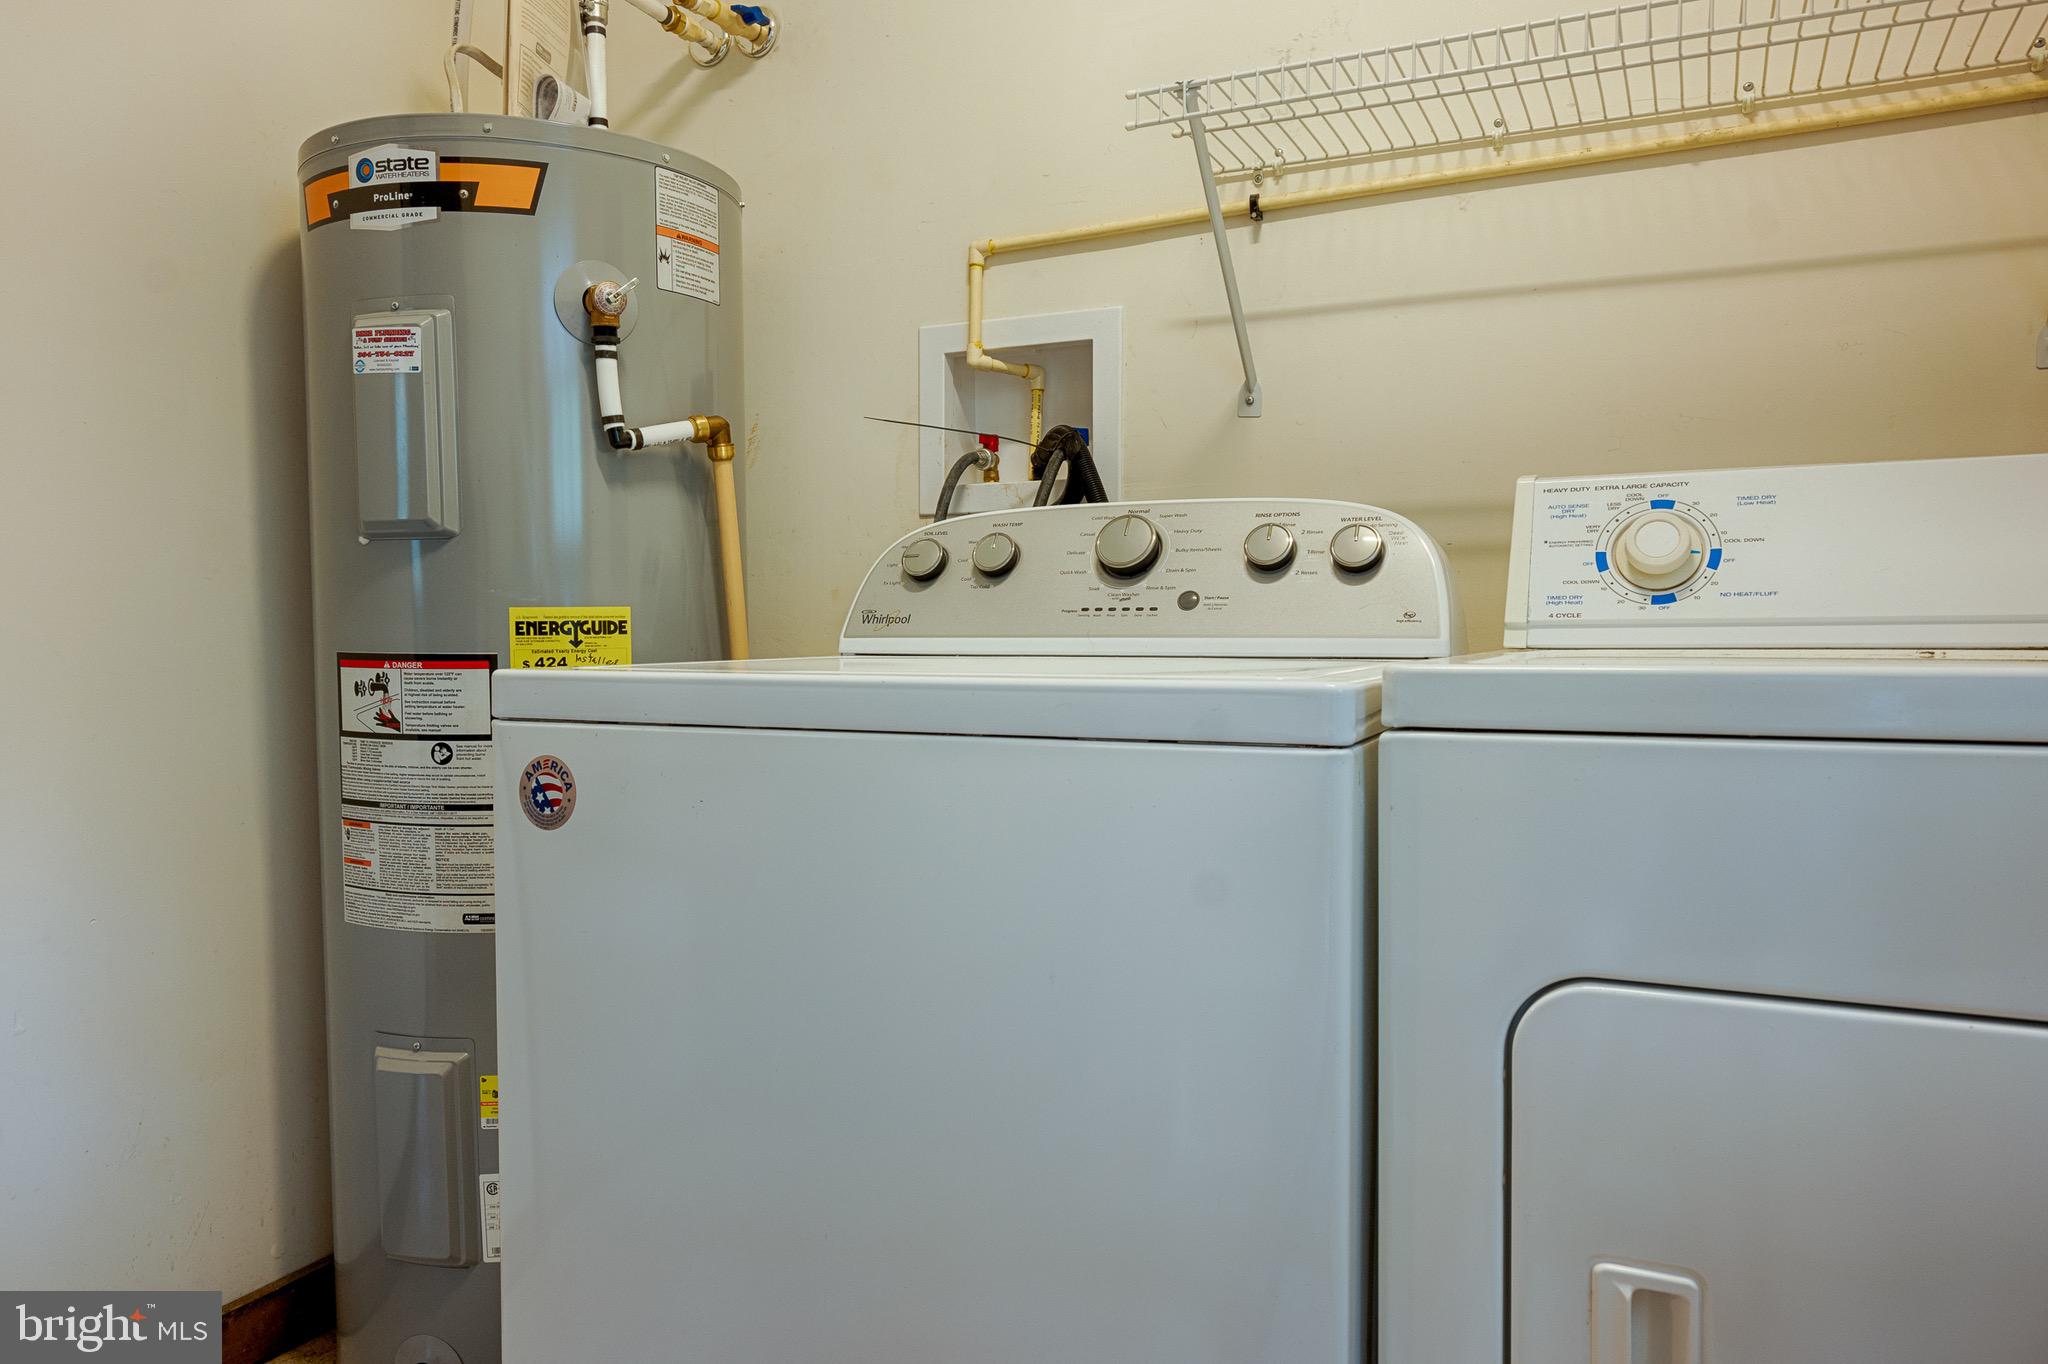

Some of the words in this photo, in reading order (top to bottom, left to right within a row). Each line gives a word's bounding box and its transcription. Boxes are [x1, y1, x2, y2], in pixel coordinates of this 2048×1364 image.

[376, 157, 429, 173] state
[374, 192, 410, 202] ProLine
[862, 613, 911, 627] Whirlpool
[515, 620, 628, 636] ENERGYGUIDE
[535, 656, 568, 667] 424
[525, 759, 572, 792] AMERICA
